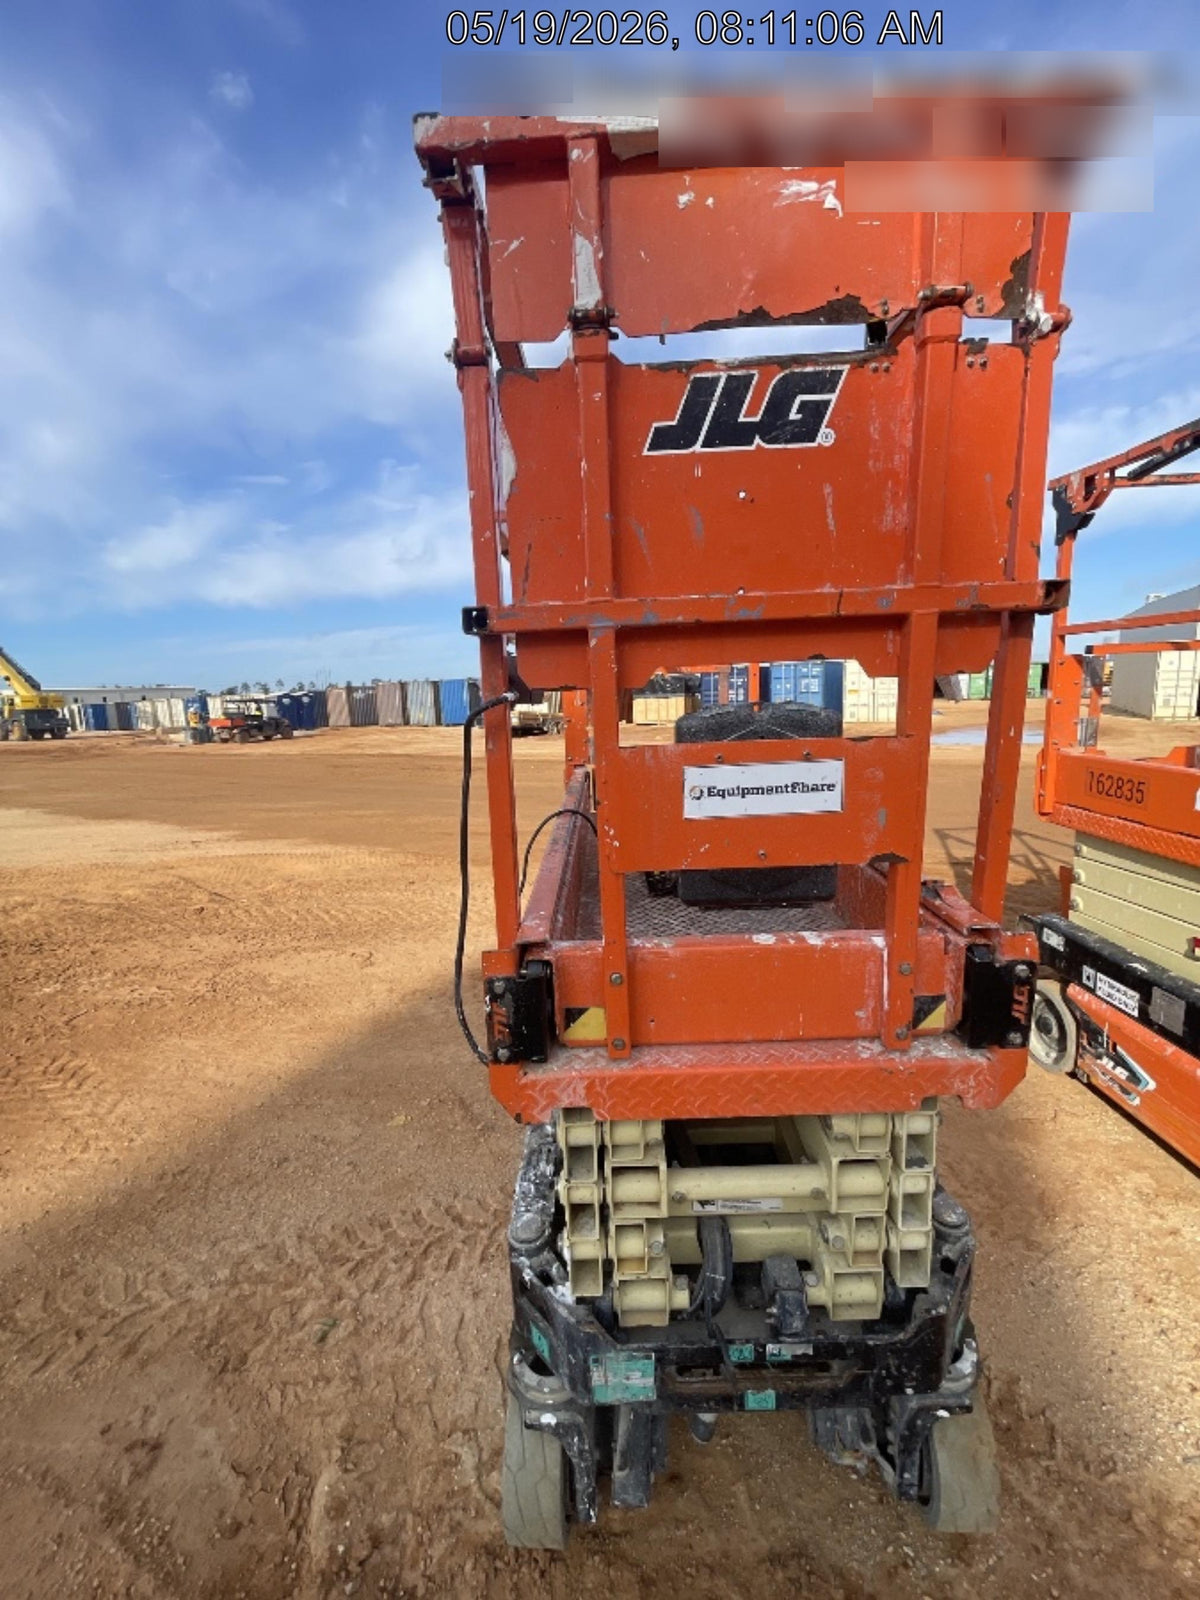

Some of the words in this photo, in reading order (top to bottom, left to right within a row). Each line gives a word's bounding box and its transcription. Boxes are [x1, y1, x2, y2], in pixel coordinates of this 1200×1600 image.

[642, 365, 850, 455] JLG
[706, 781, 836, 799] EquipmentShare
[1011, 984, 1029, 1025] JLG
